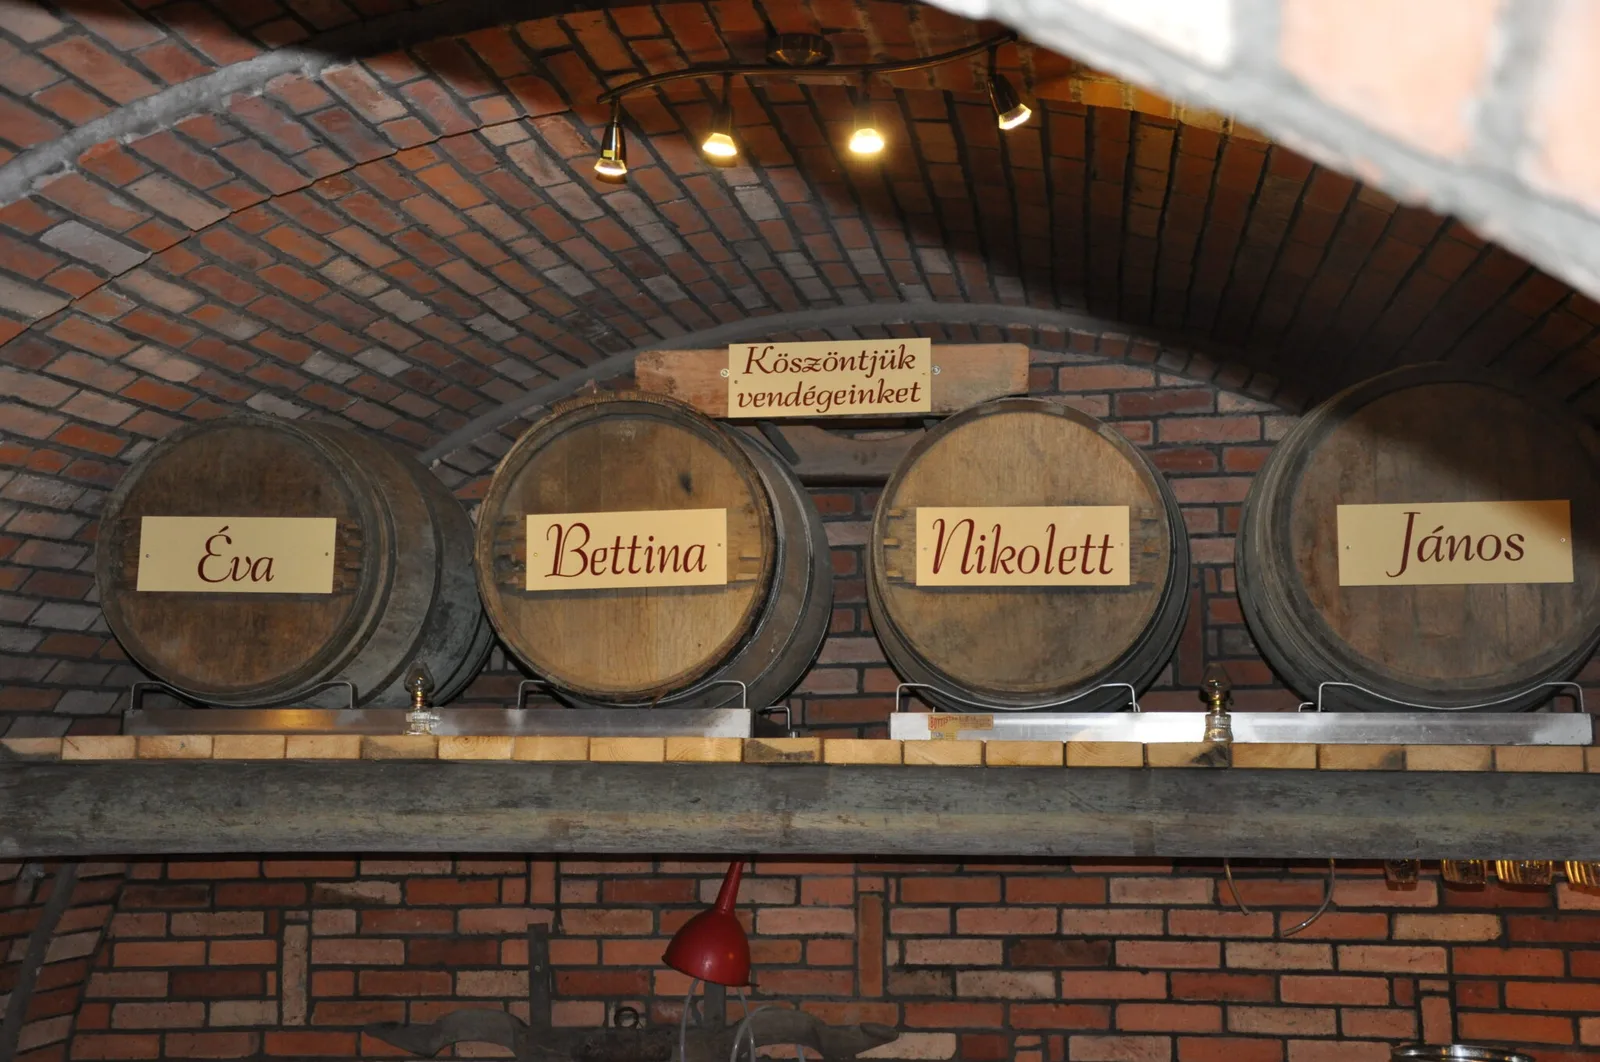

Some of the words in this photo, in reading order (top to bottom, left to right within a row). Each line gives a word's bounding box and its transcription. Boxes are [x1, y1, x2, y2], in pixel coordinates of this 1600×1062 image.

[742, 343, 916, 378] Köszöntjük
[737, 378, 921, 414] vendégeinket
[197, 525, 275, 584] Éva
[545, 522, 708, 578] Bettina
[932, 518, 1115, 576] Nikolett
[1386, 511, 1526, 578] János
